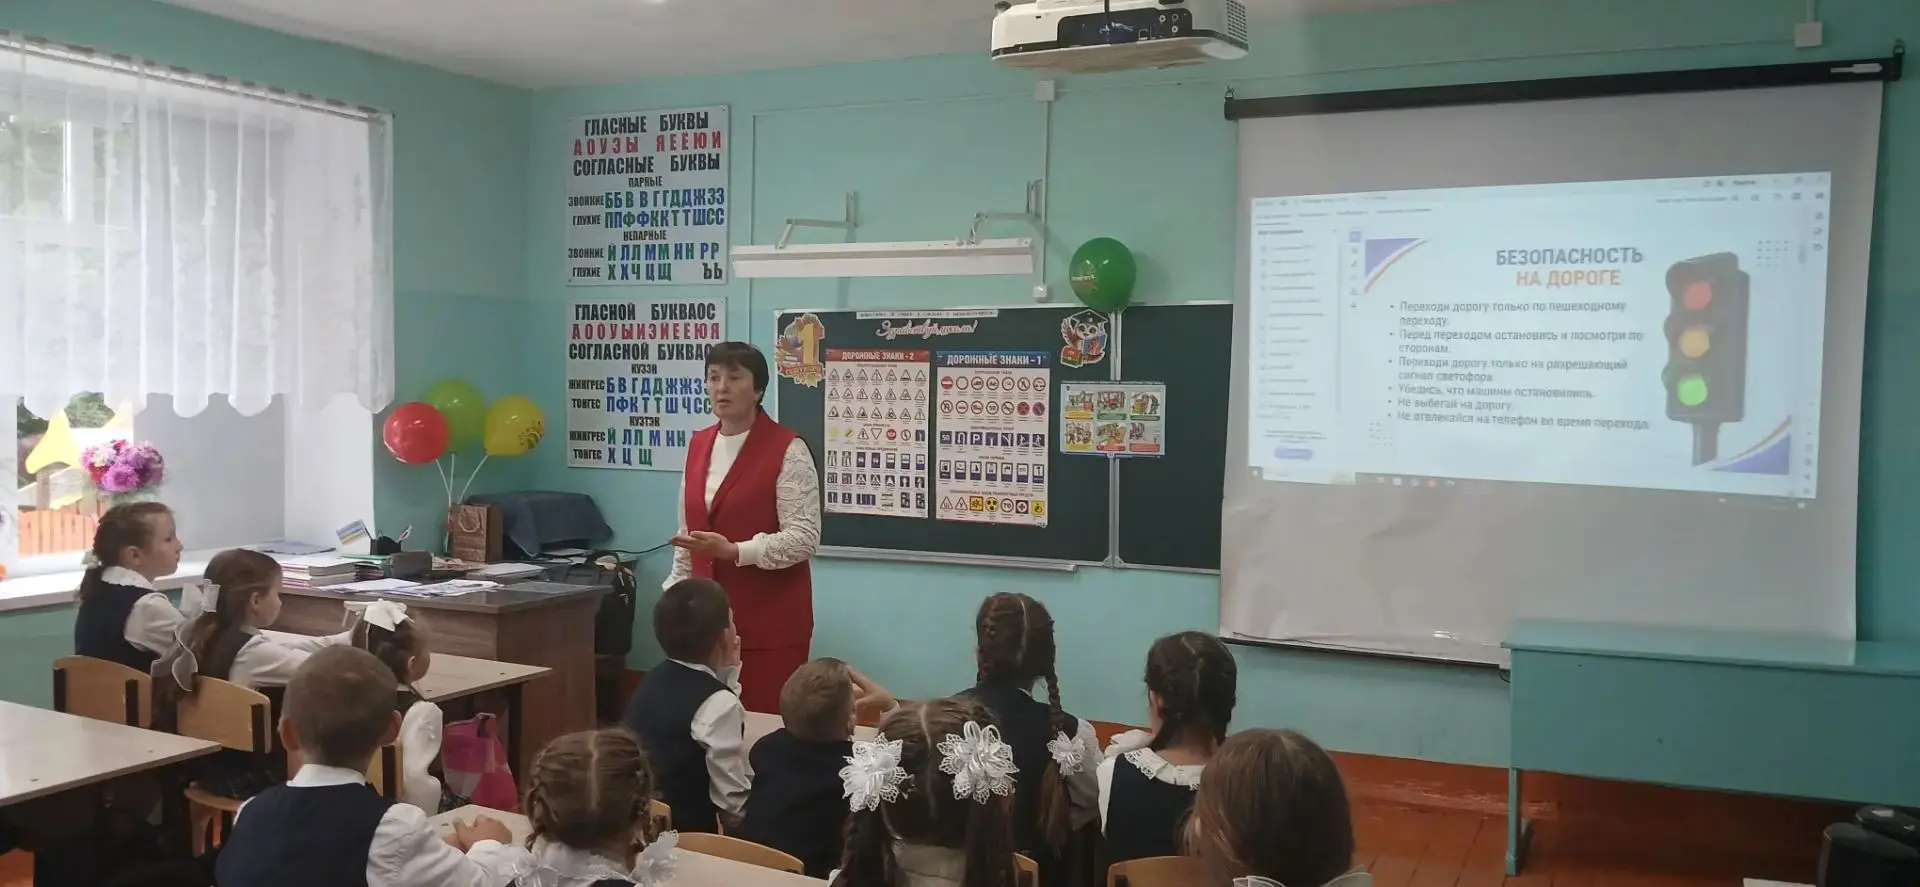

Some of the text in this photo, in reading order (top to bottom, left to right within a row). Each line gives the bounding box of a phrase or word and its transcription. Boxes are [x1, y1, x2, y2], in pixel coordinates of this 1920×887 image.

[585, 112, 709, 136] ГЛАСНЫЕ БУКВЫ
[573, 153, 720, 176] СОГЛАСНЫЕ БУКВЫ
[628, 176, 663, 187] ПАРНЫЕ
[568, 195, 604, 207] ЗВОНКИЕ
[573, 214, 601, 226] ГЛУХИЕ
[623, 230, 667, 241] НЕПАРНЫЕ
[568, 248, 604, 259] ЗВОНКИЕ
[1495, 247, 1644, 265] БЕЗОПАСНОСТЬ
[573, 266, 601, 277] ГЛУХИЕ
[1516, 269, 1622, 289] НА ДОРОГЕ
[575, 302, 716, 320] ГЛАСНОЙ БУКВАОС
[1400, 301, 1627, 313] Переходи дорогу только по пешеходному
[1400, 329, 1643, 342] Перед переходом остановись и посмотри по
[569, 342, 711, 360] СОГЛАСНОЙ БУКВАО
[842, 351, 880, 360] ДОРОЖНЫЕ
[882, 351, 904, 360] ЗНАКИ
[947, 354, 997, 365] ДОРОЖНЫЕ
[1000, 354, 1029, 365] ЗНАКИ
[1399, 356, 1628, 371] Переходи дорогу только на разрешающий
[1446, 387, 1465, 395] что
[1467, 387, 1512, 396] машины
[1398, 398, 1411, 407] Не
[1414, 398, 1458, 409] выбегай
[1460, 400, 1473, 409] на
[1398, 411, 1411, 421] Не
[1413, 412, 1474, 422] отвлекайся
[1477, 415, 1490, 423] на
[1492, 415, 1538, 427] телефон
